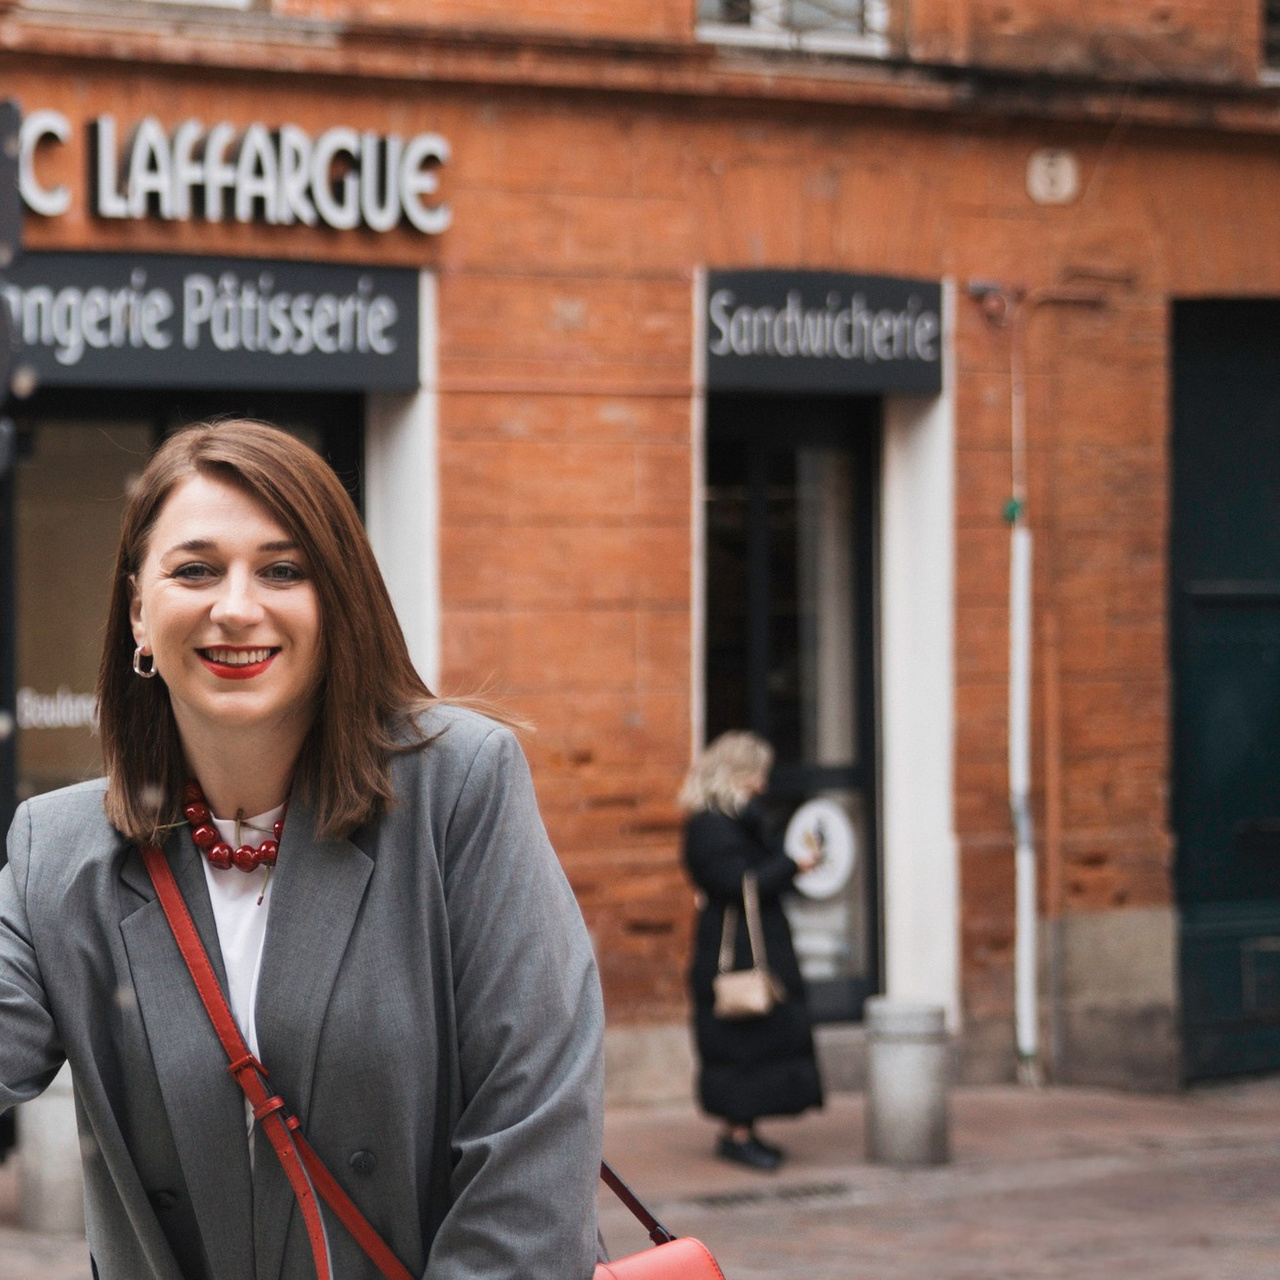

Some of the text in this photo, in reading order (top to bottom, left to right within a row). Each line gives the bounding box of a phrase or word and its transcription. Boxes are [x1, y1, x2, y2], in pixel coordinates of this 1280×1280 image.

[98, 115, 451, 235] LAFFARGUE
[183, 272, 399, 356] Pâtisserie
[709, 287, 940, 364] Sandwicherie
